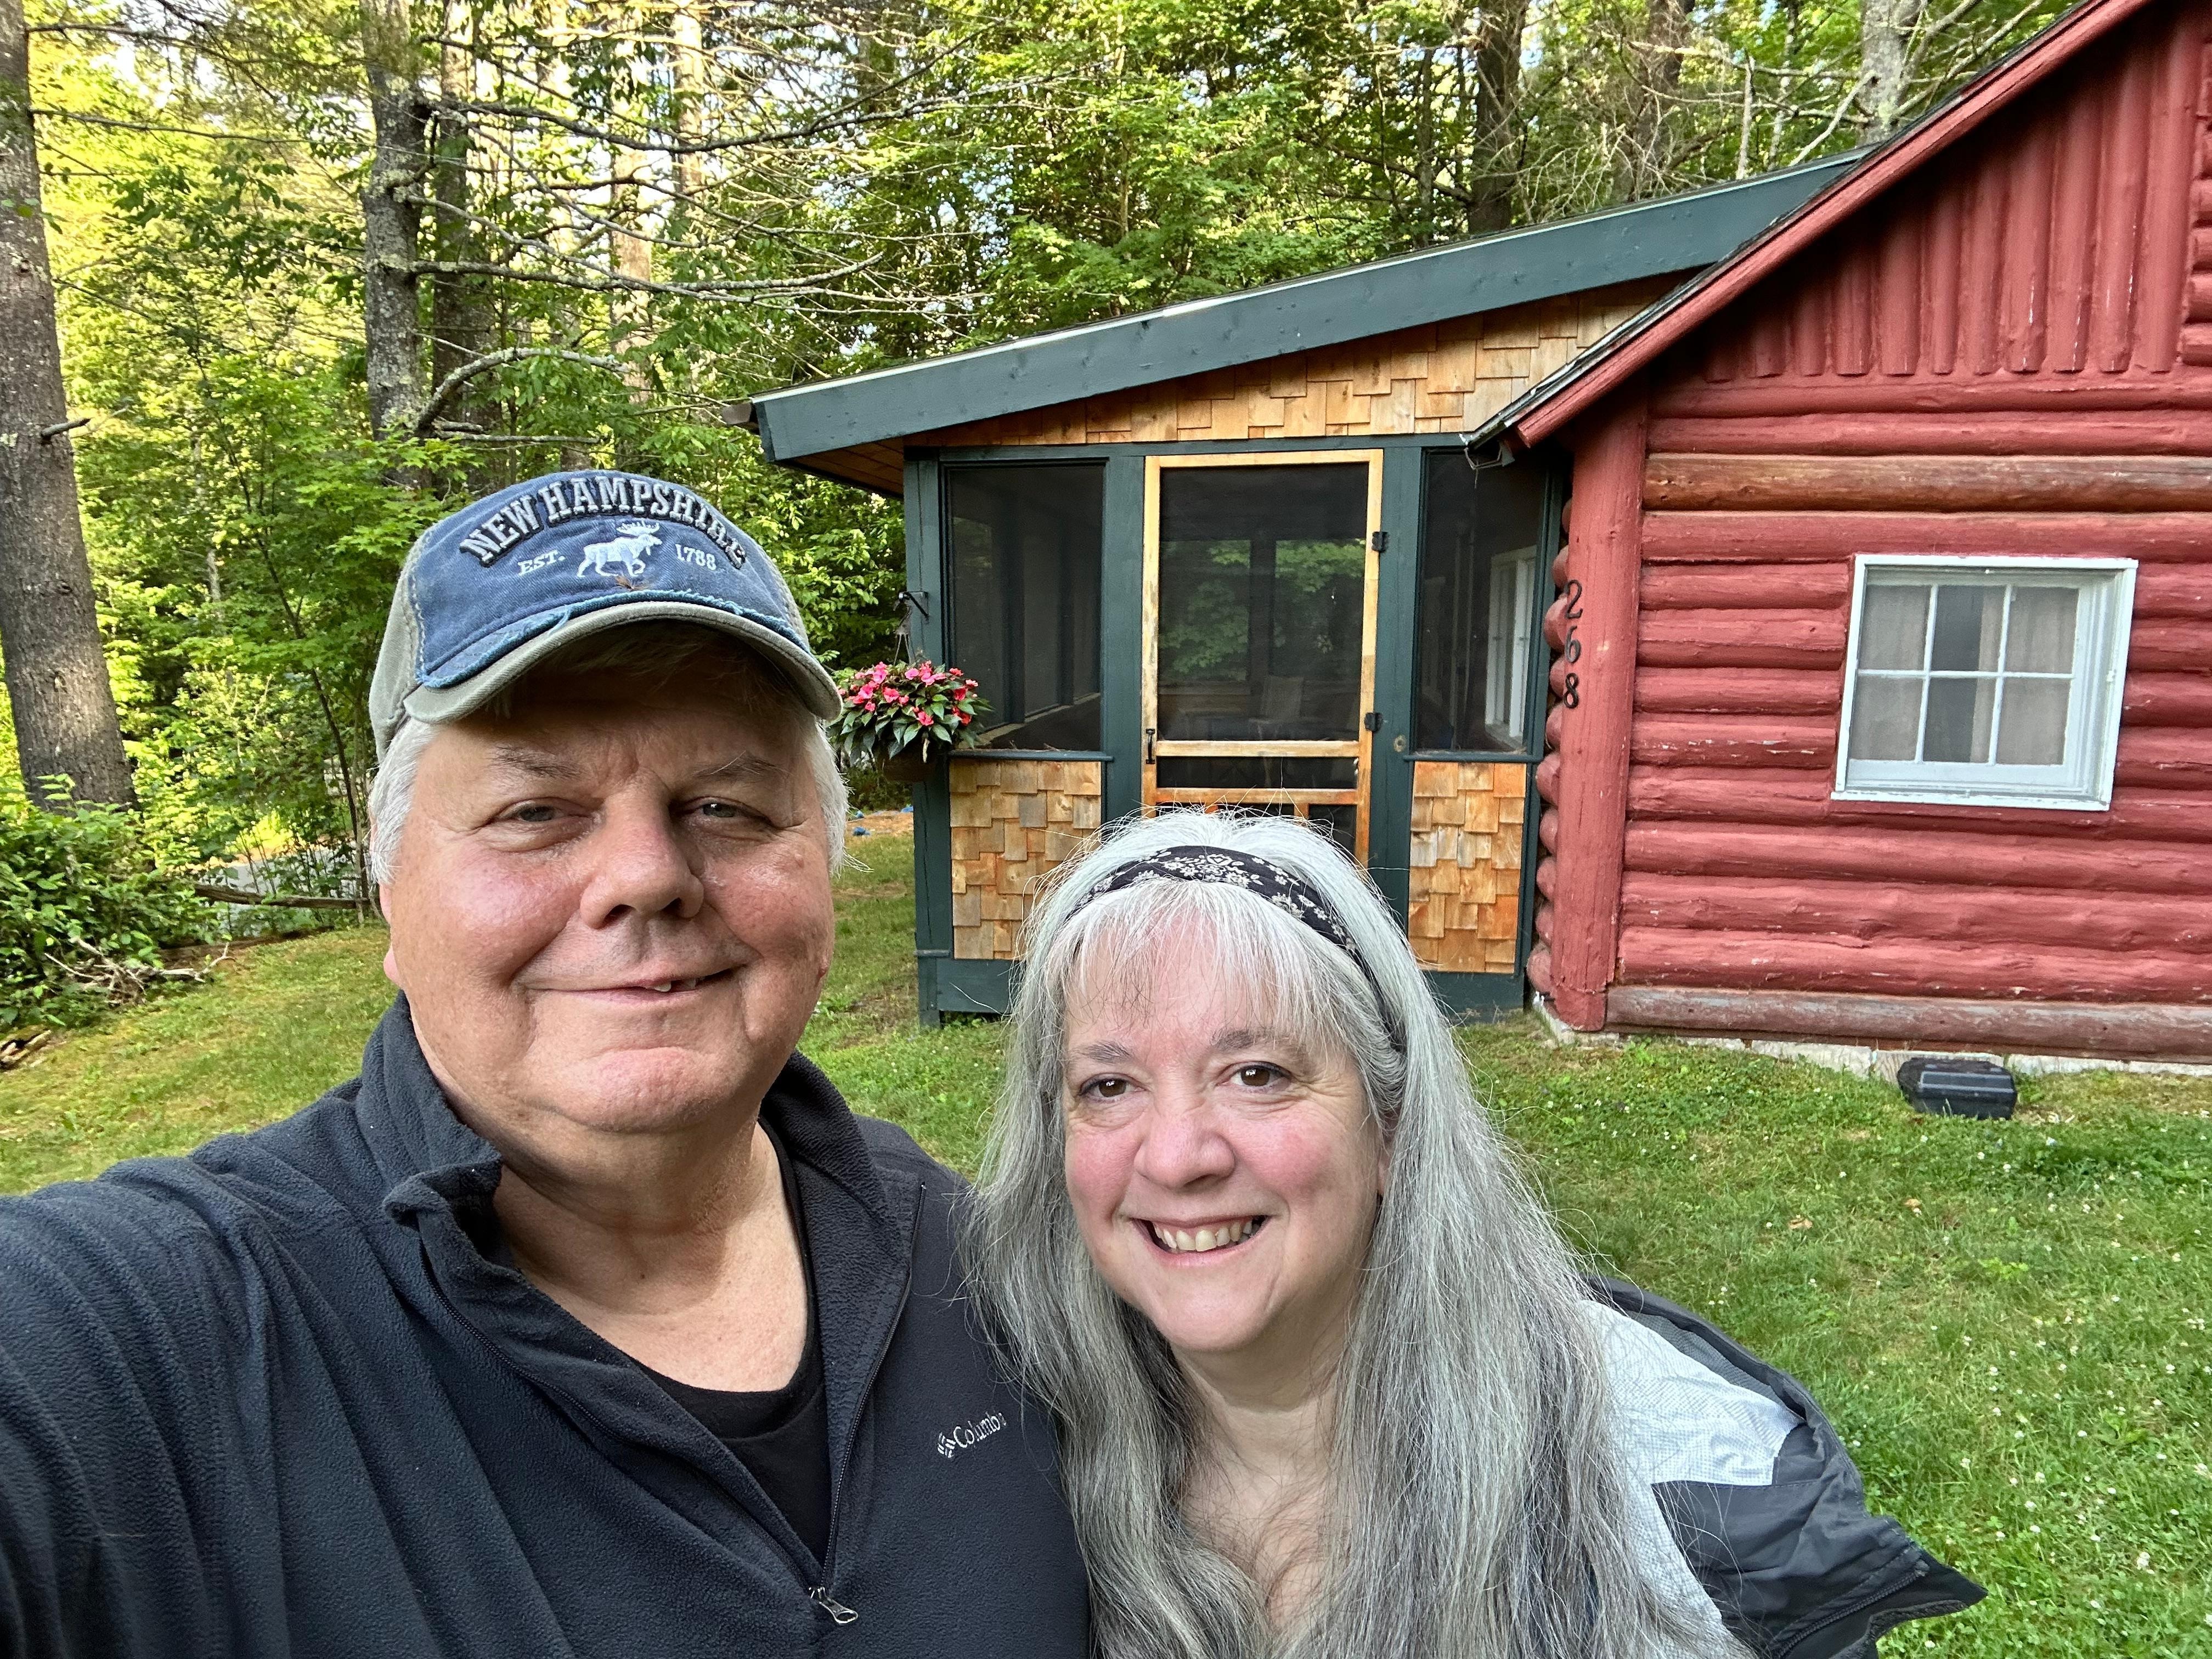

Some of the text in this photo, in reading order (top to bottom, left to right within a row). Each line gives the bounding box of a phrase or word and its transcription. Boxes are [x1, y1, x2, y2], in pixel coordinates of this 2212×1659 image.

[460, 476, 746, 569] NEW HAMPSHIRE
[517, 549, 566, 577] EST.
[675, 544, 716, 571] 1788
[1564, 579, 1583, 708] 268
